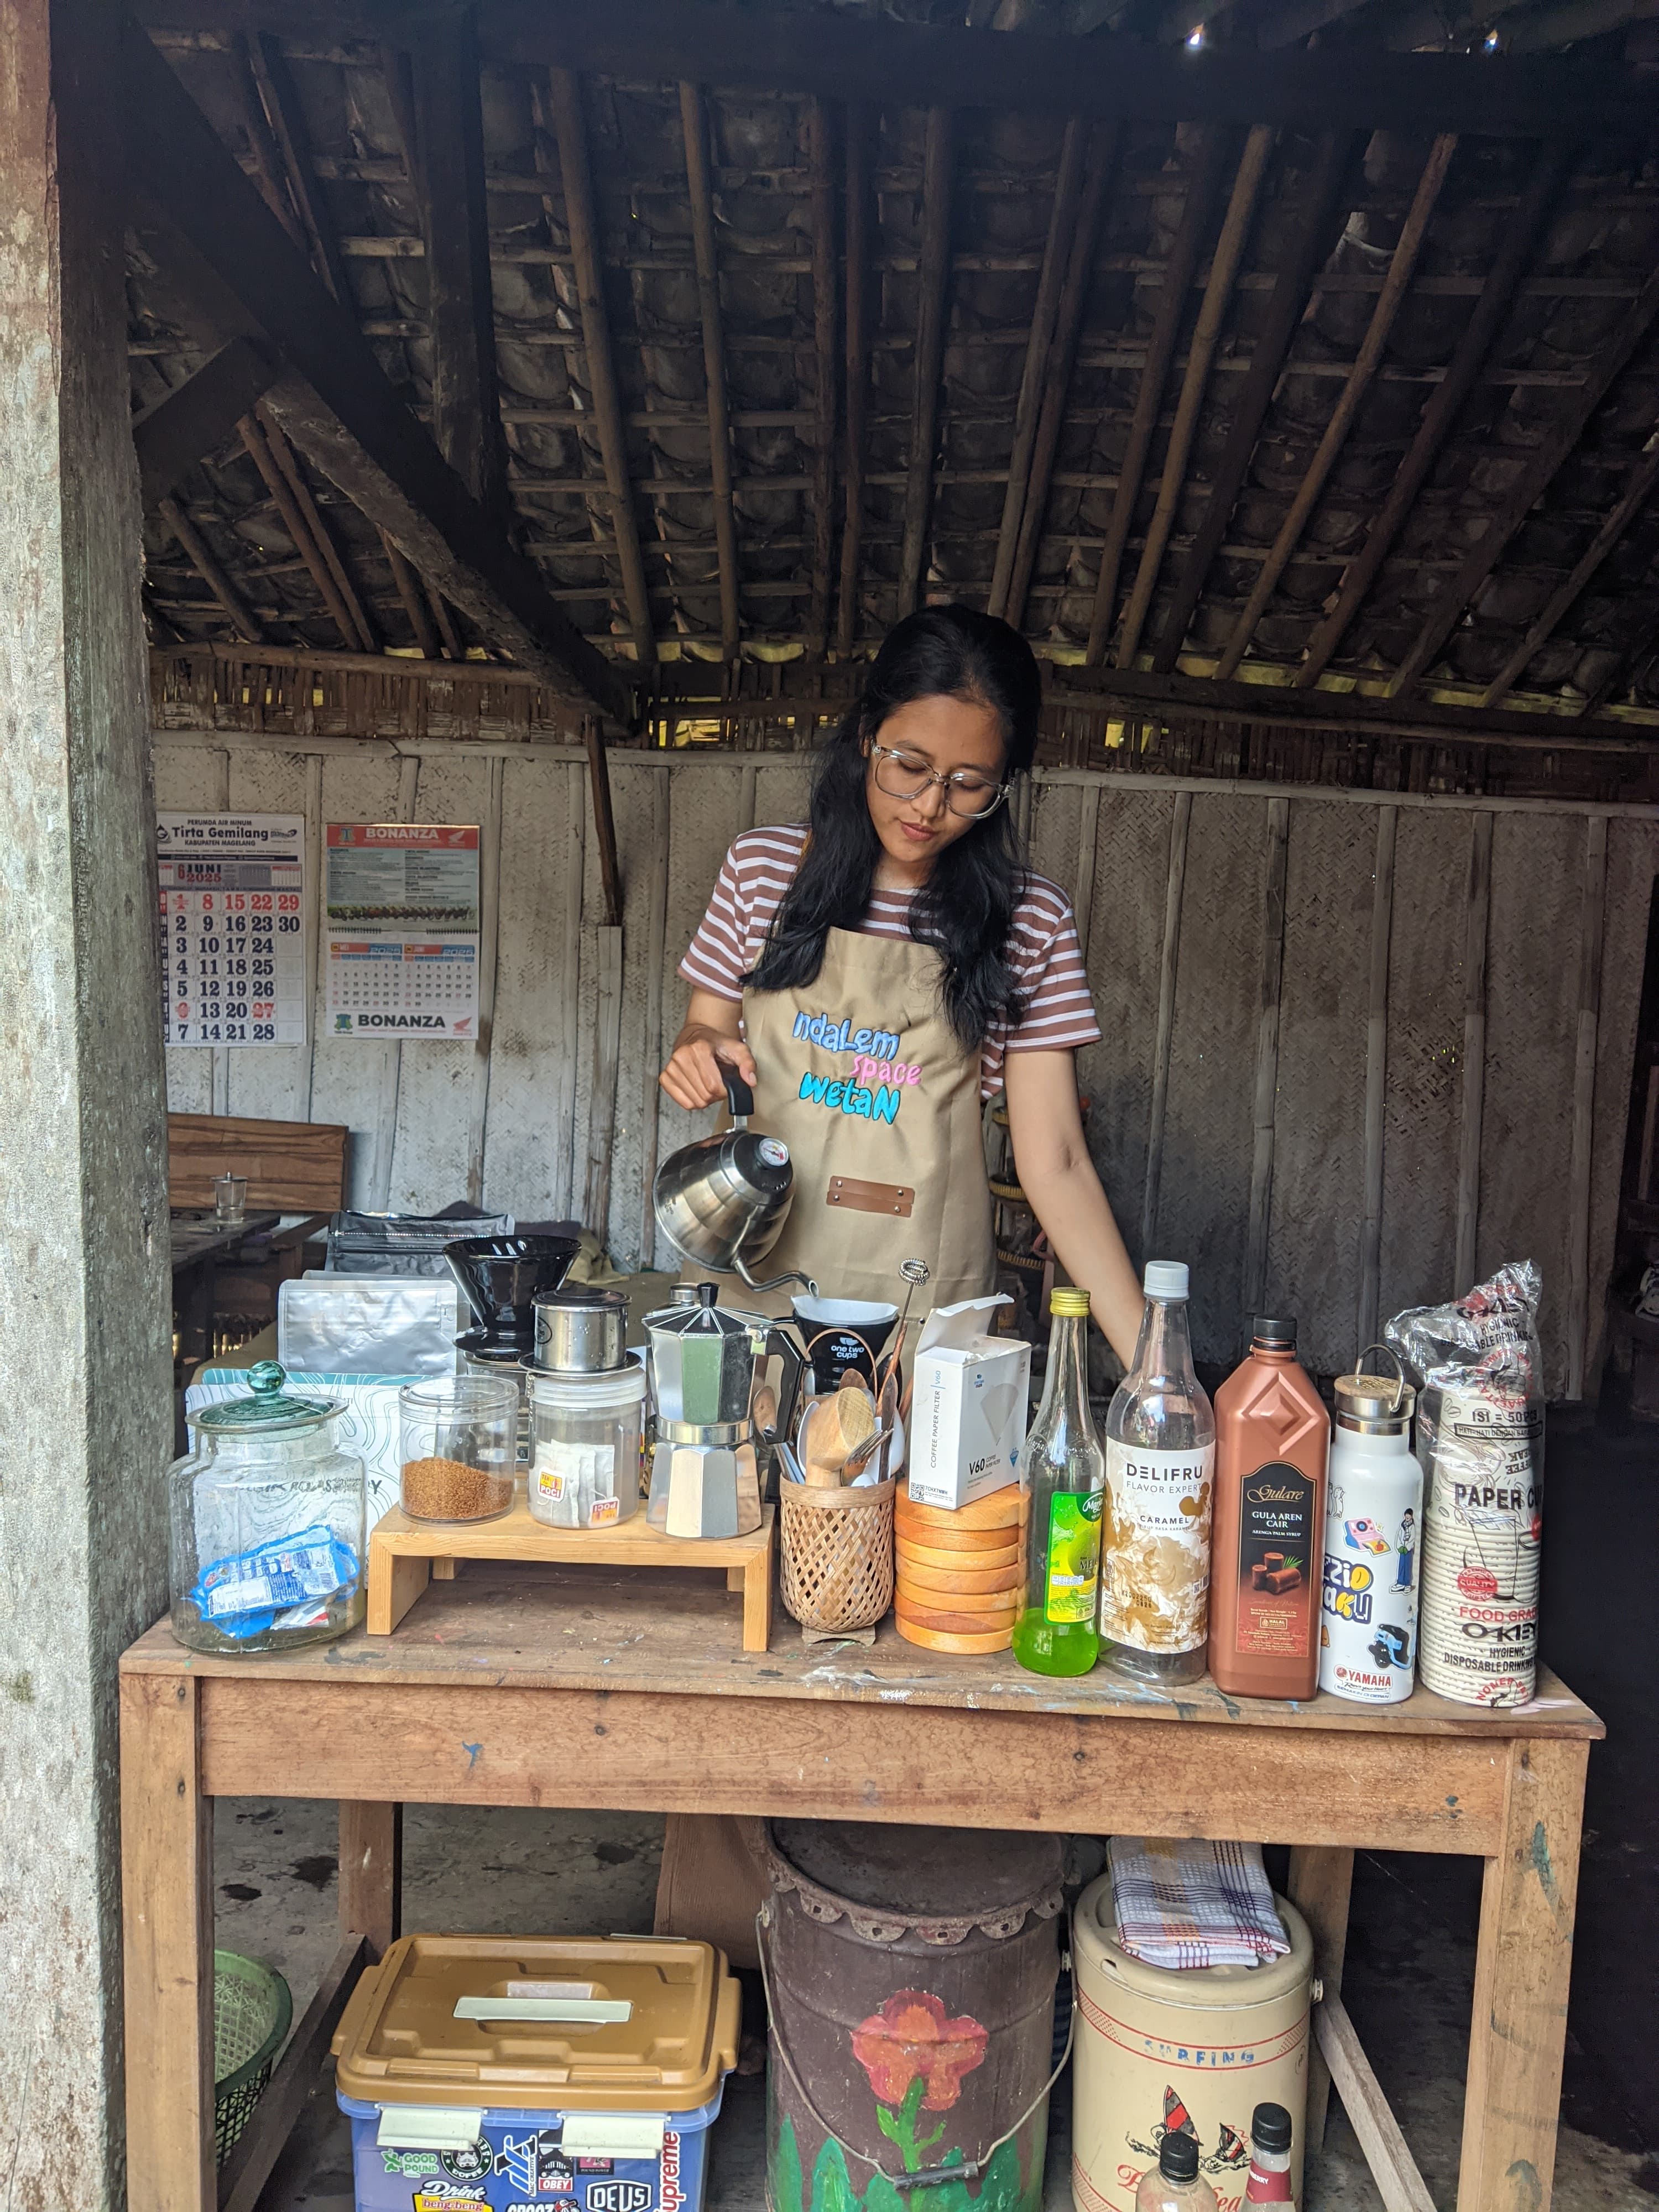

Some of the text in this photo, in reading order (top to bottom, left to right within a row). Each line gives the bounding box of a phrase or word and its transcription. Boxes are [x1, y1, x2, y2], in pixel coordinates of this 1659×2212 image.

[172, 827, 204, 837] Tirta
[208, 827, 268, 841] Gemilang
[366, 827, 439, 839] BONANZA
[178, 864, 221, 879] 6 JUNI
[187, 873, 221, 882] 2025
[202, 894, 213, 910] 8
[225, 894, 245, 910] 15
[251, 894, 273, 910] 22
[278, 894, 299, 910] 29
[176, 916, 300, 932] 2 9 16 23 30
[176, 937, 274, 953] 3 10 17 24
[176, 959, 274, 975] 4 11 18 25
[178, 980, 274, 997] 5 12 19 26
[201, 1002, 220, 1018] 13
[226, 1003, 247, 1018] 20
[358, 1014, 446, 1027] BONANZA
[178, 1024, 274, 1040] 7 14 21 28
[849, 1055, 922, 1086] space
[836, 1352, 858, 1360] cups
[1473, 1411, 1490, 1422] ISI
[969, 1458, 985, 1475] V60
[1126, 1463, 1203, 1481] DELIFRU
[541, 1485, 560, 1498] POCI
[1126, 1480, 1202, 1494] FLAVOR EXPERT
[1247, 1485, 1304, 1503] Gulare
[1455, 1483, 1522, 1510] PAPER
[594, 1502, 616, 1512] POCI
[1140, 1515, 1189, 1524] CARAMEL
[1252, 1511, 1302, 1521] GULA AREN
[1459, 1579, 1495, 1588] QUALITY
[1460, 1606, 1504, 1621] FOOD
[1490, 1646, 1525, 1659] HYGIENIC
[1444, 1652, 1501, 1673] DISPOSABLE
[1348, 1670, 1391, 1687] YAMAHA
[1475, 1677, 1514, 1702] NOMER
[404, 2153, 437, 2163] GOOD
[404, 2164, 439, 2173] POUND
[662, 2132, 685, 2212] upreme
[421, 2180, 486, 2200] Drink
[542, 2180, 569, 2189] OBEY
[424, 2199, 484, 2211] beng-beng
[594, 2185, 645, 2212] DEUS
